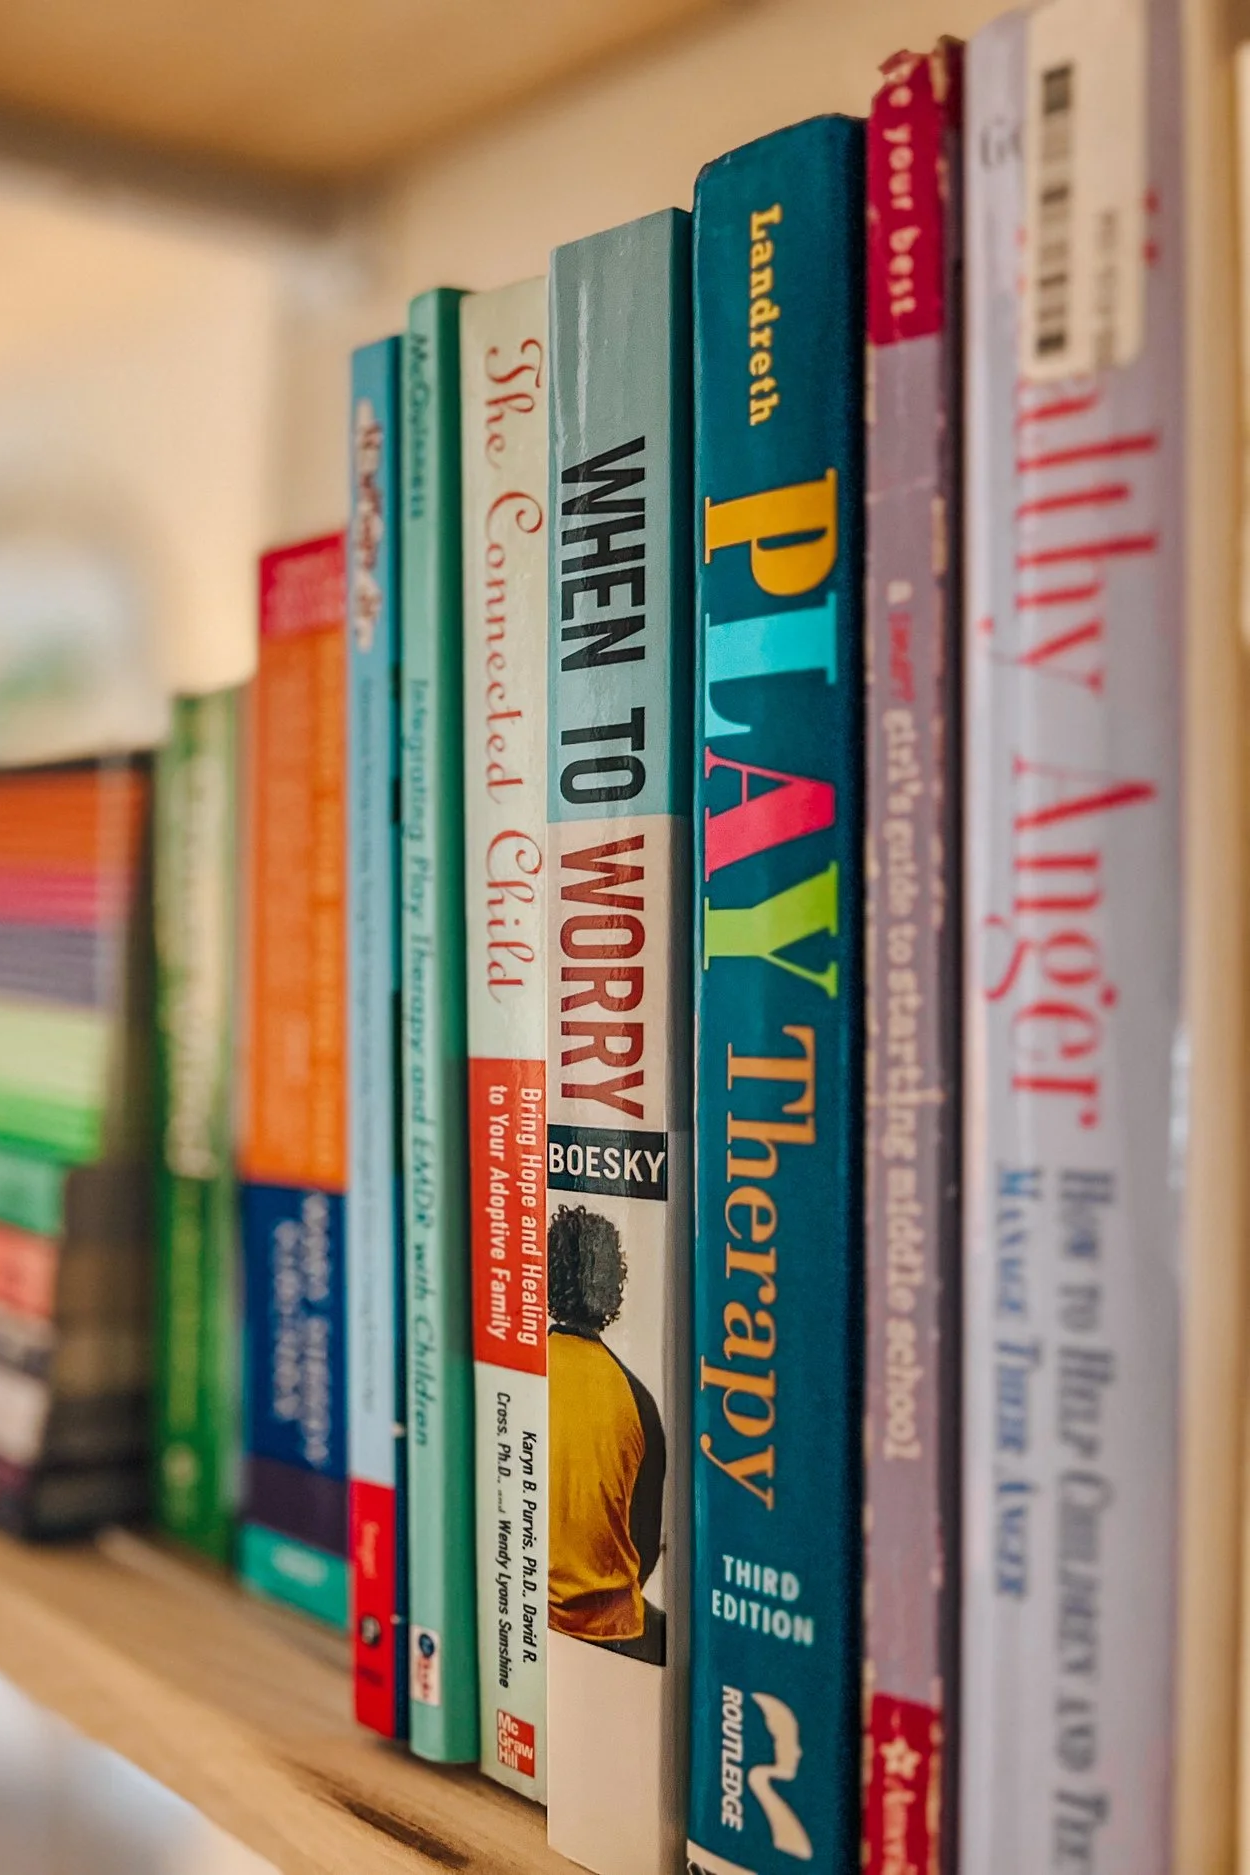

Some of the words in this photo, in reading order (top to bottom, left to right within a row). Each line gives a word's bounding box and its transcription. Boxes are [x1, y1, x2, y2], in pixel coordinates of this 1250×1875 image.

[884, 124, 913, 212] your
[886, 226, 916, 316] best
[749, 203, 782, 427] Landreth
[484, 338, 545, 470] The
[561, 434, 647, 673] WHEN
[976, 380, 1160, 695] althy
[484, 490, 544, 806] Connected
[402, 678, 430, 841] Integrating
[560, 706, 647, 805] TO
[705, 467, 838, 1000] PLAY
[883, 707, 921, 814] girl's
[403, 856, 432, 916] Play
[885, 818, 921, 917] guide
[485, 829, 544, 1004] Child
[886, 922, 918, 965] to
[983, 753, 1161, 1130] Anger
[406, 932, 435, 1055] Therapy
[560, 833, 645, 1121] WORRY
[410, 1066, 435, 1123] and
[487, 1084, 505, 1107] to
[884, 968, 930, 1158] starting
[489, 1112, 511, 1160] Your
[516, 1087, 543, 1145] Bring
[411, 1136, 435, 1229] EMDR
[518, 1150, 544, 1207] Hope
[548, 1140, 667, 1184] BOESKY
[485, 1164, 511, 1258] Adoptive
[521, 1211, 544, 1248] and
[886, 1167, 926, 1312] middle
[412, 1243, 436, 1301] with
[485, 1264, 511, 1341] Family
[517, 1252, 545, 1347] Healing
[700, 1024, 817, 1510] Therapy
[411, 1314, 437, 1447] Children
[496, 1391, 511, 1437] Cross,
[884, 1318, 925, 1462] school
[497, 1442, 512, 1483] Ph.D.,
[522, 1429, 538, 1478] Karyn
[523, 1482, 538, 1493] B.
[498, 1519, 512, 1568] Wendy
[522, 1497, 538, 1548] Purvis,
[498, 1571, 511, 1615] Lyons
[522, 1554, 539, 1598] Ph.D.,
[722, 1554, 801, 1601] THIRD
[498, 1619, 513, 1689] Sunshine
[522, 1601, 539, 1643] David
[523, 1647, 538, 1664] R.
[712, 1590, 815, 1648] EDITION
[497, 1731, 534, 1761] Graw
[497, 1748, 519, 1769] Hill
[498, 1711, 520, 1736] Mc
[721, 1684, 744, 1832] ROUTLEDGE
